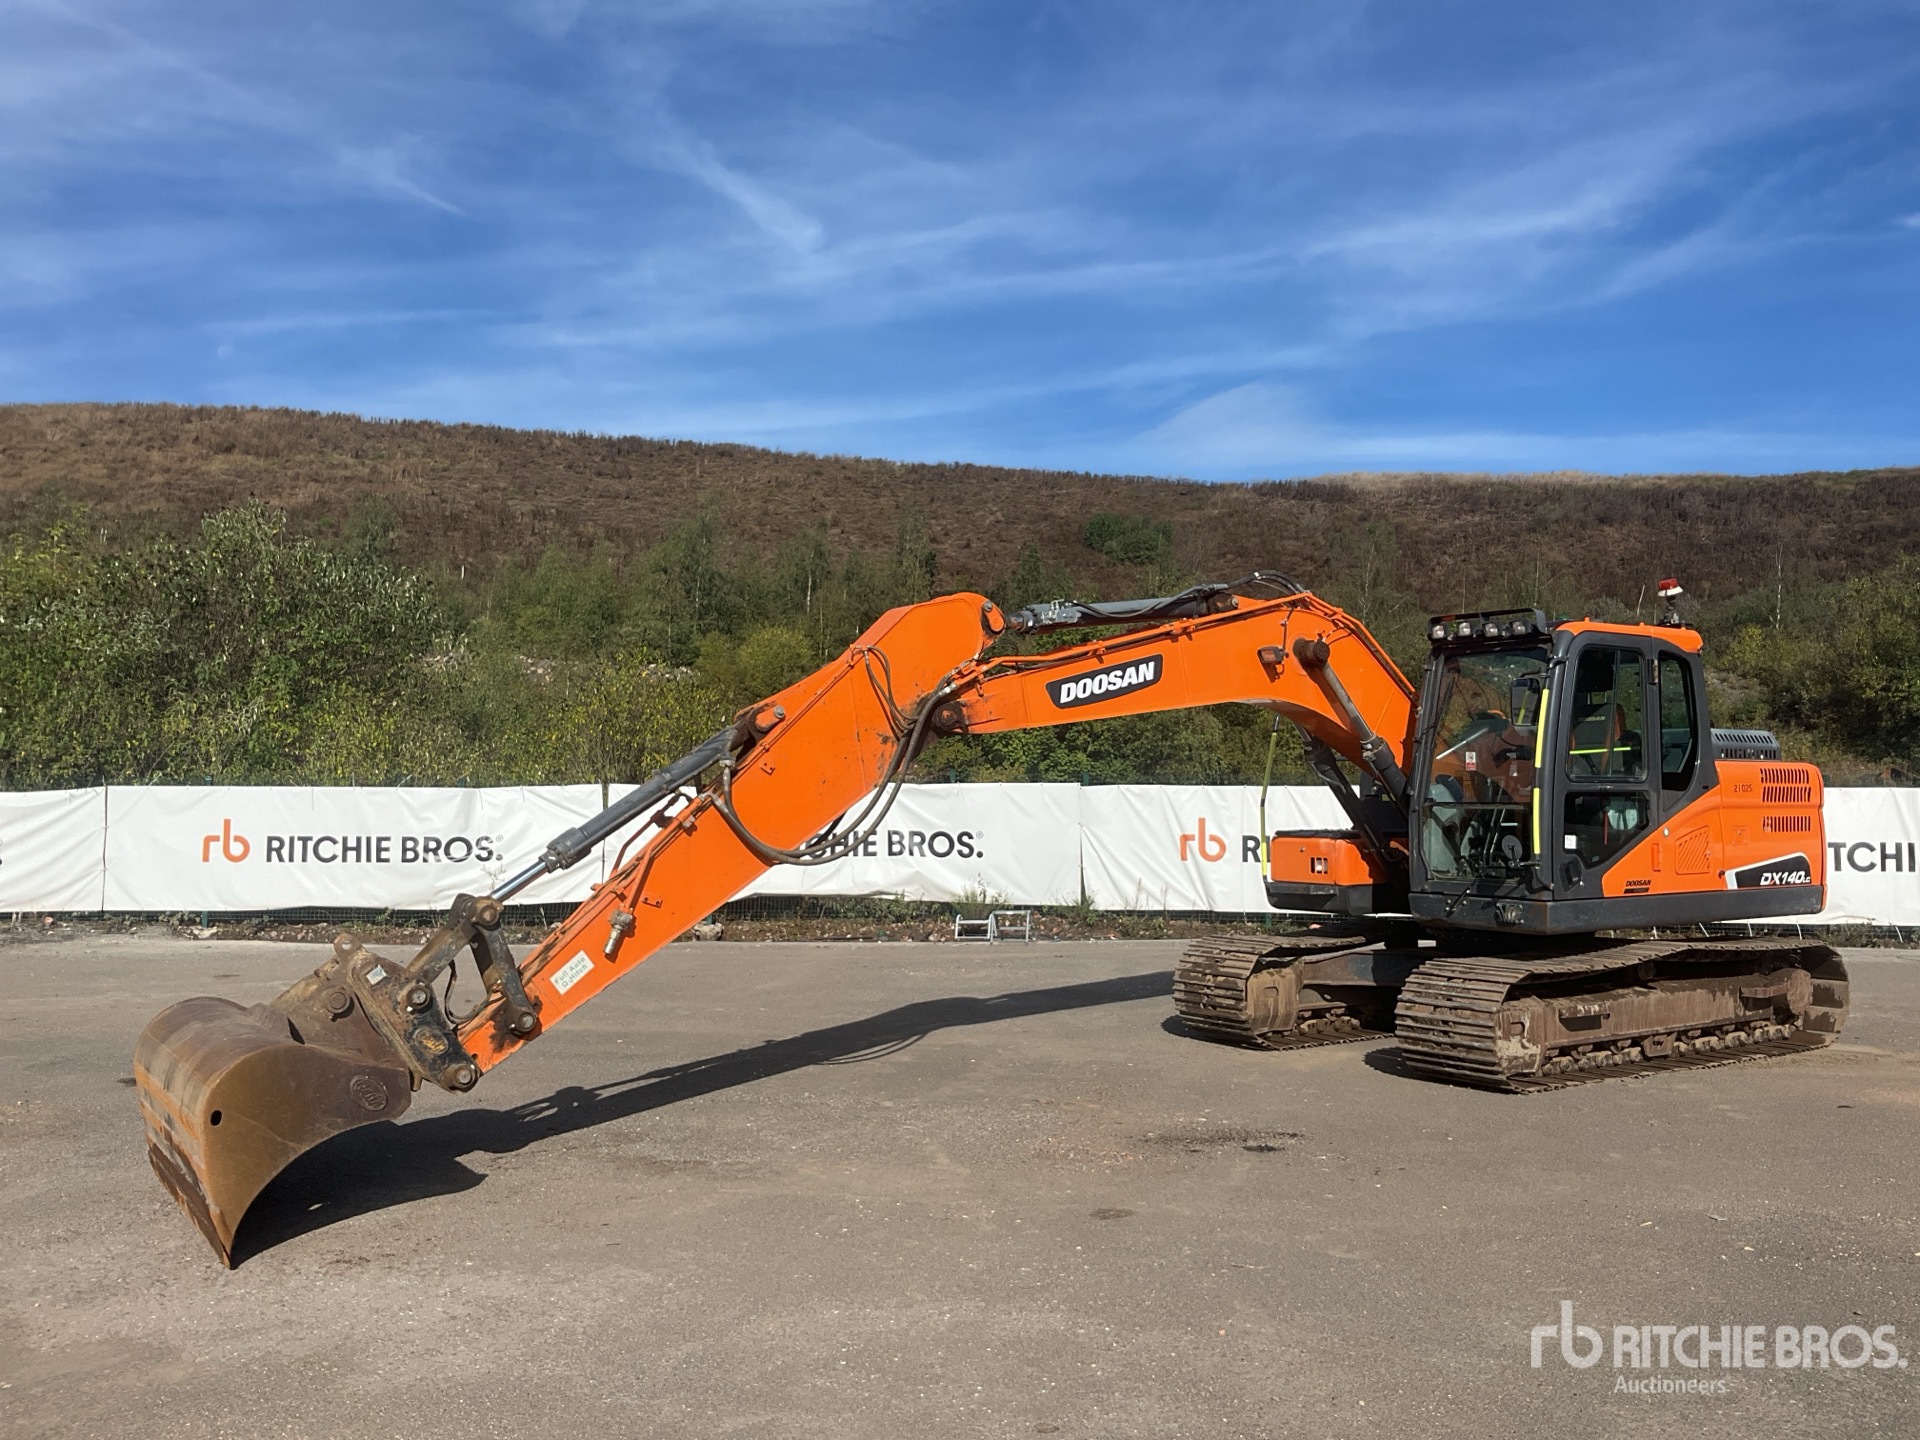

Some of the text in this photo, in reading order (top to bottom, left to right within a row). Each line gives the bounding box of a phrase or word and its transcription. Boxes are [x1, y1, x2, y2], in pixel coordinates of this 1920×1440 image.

[1060, 661, 1155, 704] DOOSAN
[266, 835, 391, 863] RITCHIE
[1625, 879, 1652, 887] DOOSAN
